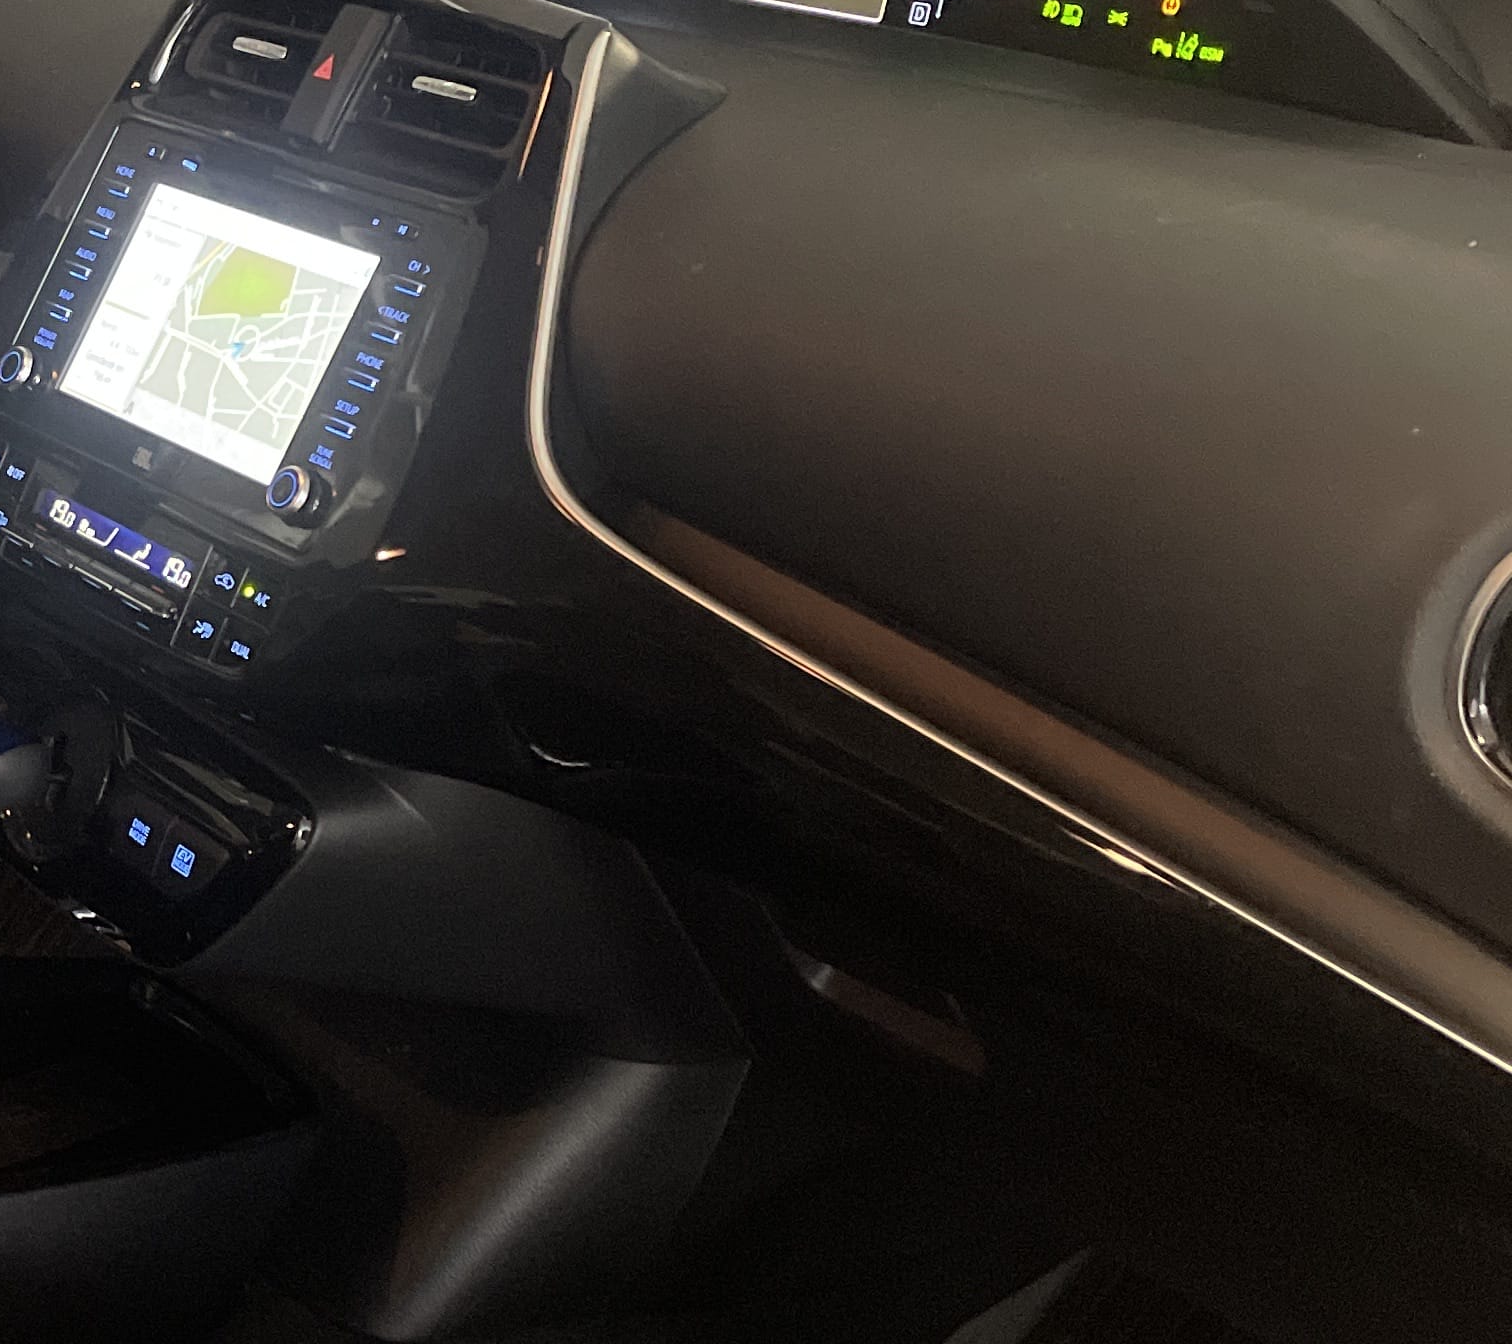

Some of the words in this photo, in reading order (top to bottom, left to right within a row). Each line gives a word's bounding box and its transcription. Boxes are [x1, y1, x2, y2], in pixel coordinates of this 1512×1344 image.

[913, 6, 925, 21] D
[115, 165, 136, 179] HOME
[76, 247, 97, 262] AUDIO
[355, 351, 385, 371] PHONE
[334, 399, 361, 416] SETUP
